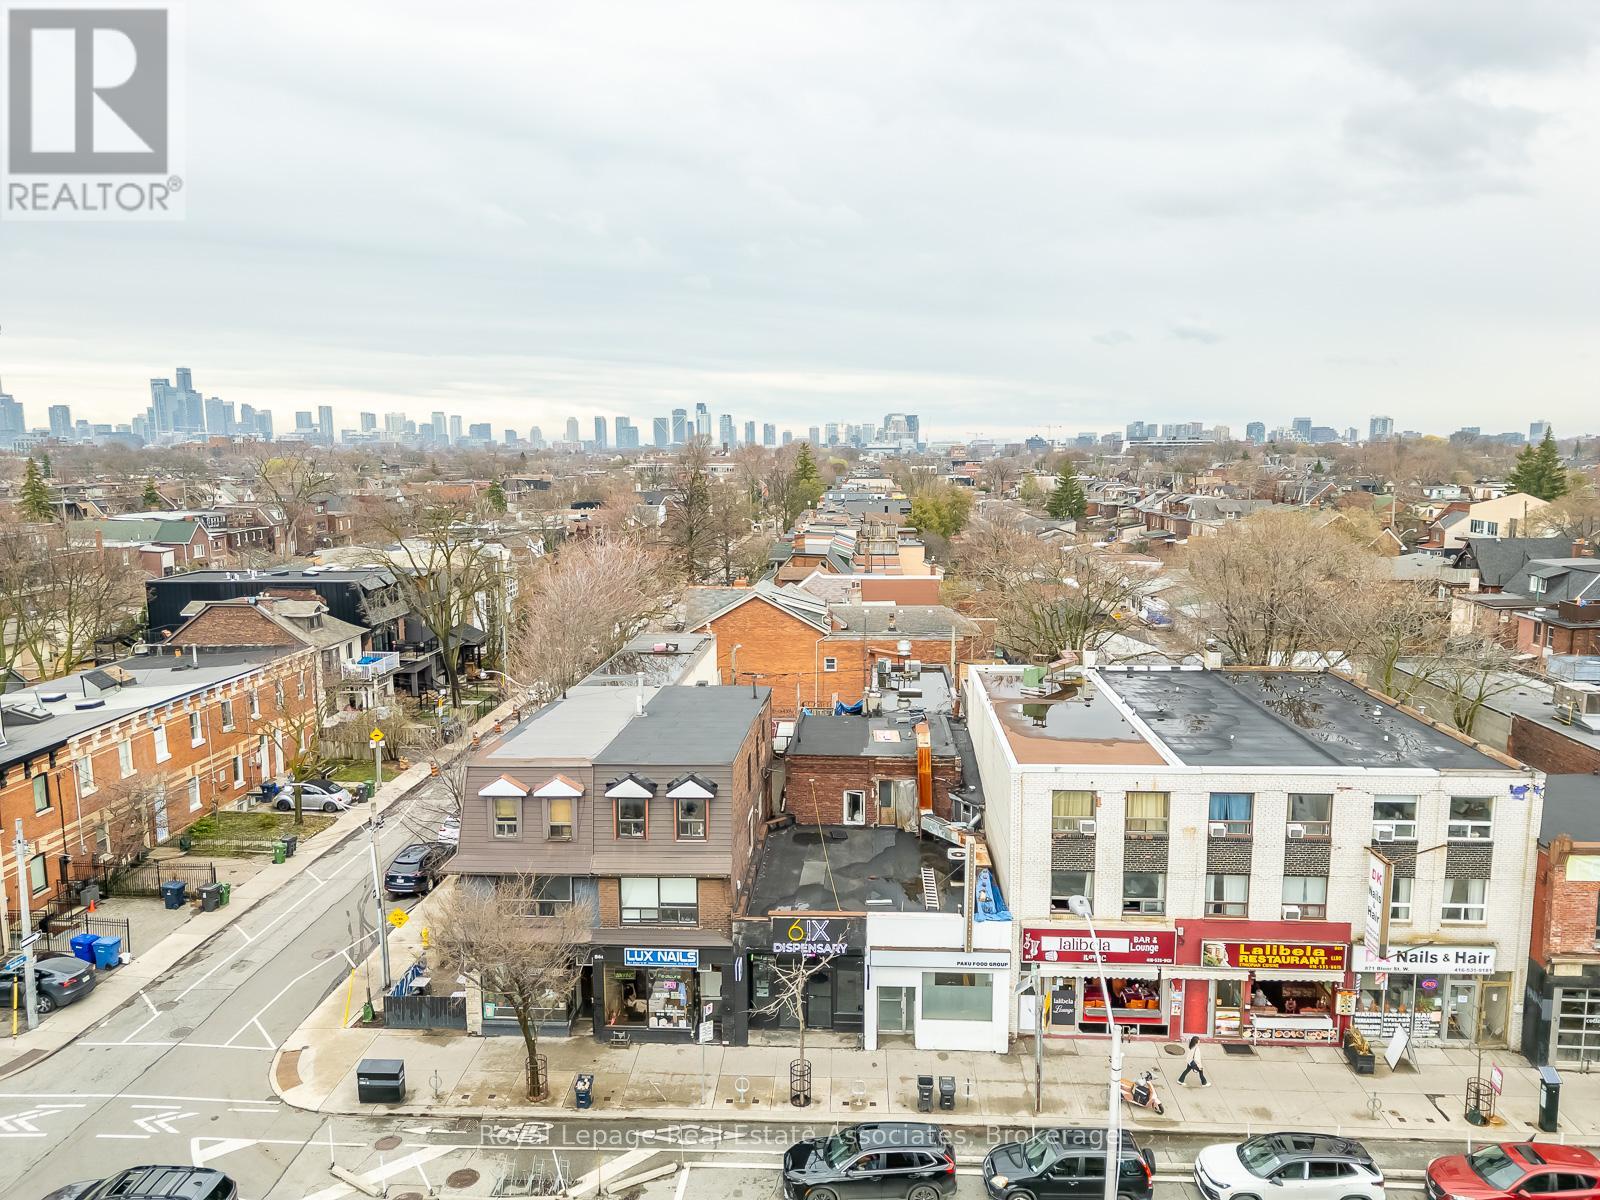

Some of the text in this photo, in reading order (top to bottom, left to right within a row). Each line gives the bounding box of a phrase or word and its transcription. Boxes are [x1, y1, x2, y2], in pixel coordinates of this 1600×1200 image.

[1371, 868, 1382, 885] DK
[1367, 905, 1380, 924] Hair
[1133, 936, 1150, 944] BAR
[773, 942, 848, 954] DISPENSARY
[1130, 943, 1159, 954] Lounge
[1239, 944, 1326, 957] Lalibela
[626, 950, 697, 962] LUX NAILS
[1239, 954, 1328, 965] RESTAURANT
[1396, 950, 1490, 964] Nails & Hair
